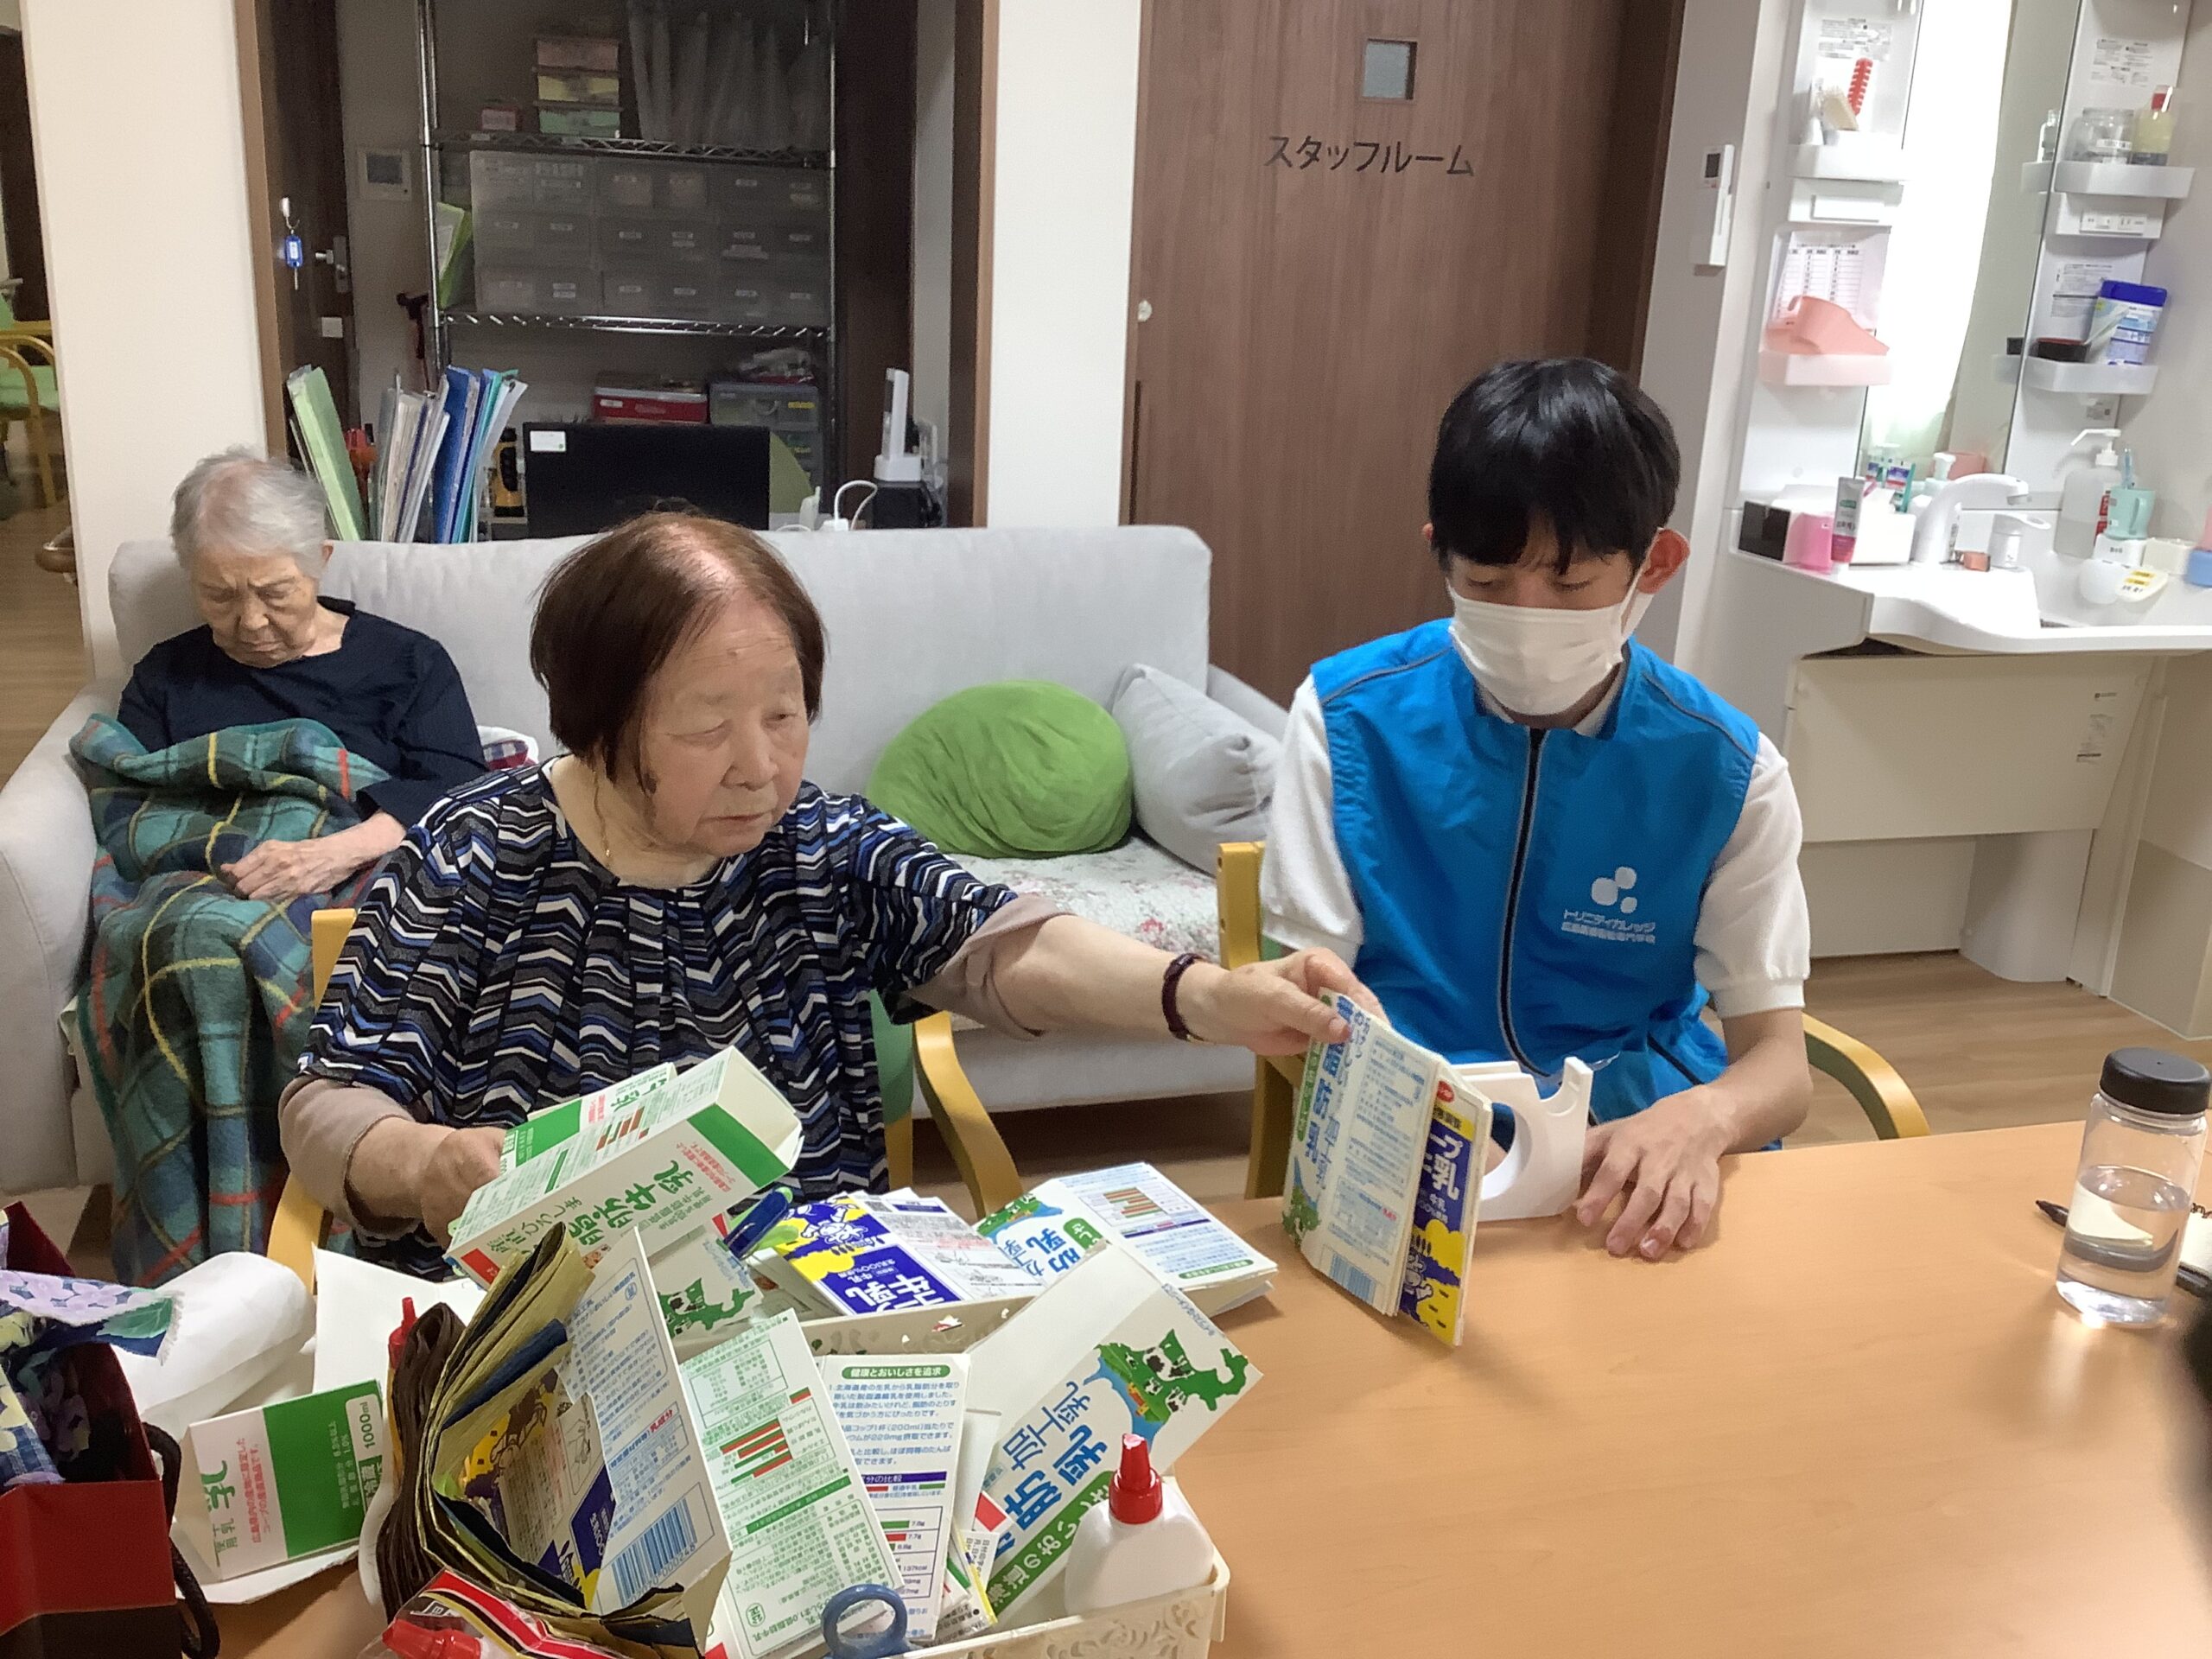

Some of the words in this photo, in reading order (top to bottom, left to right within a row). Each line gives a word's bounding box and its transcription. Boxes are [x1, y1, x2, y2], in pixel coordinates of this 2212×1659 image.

[1263, 135, 1475, 177] スタッフルーム
[845, 1274, 930, 1306] 牛乳
[851, 1366, 941, 1377] 健康とおいしさを追求
[359, 1401, 376, 1449] 1000ml
[1001, 1382, 1090, 1469] 加工乳
